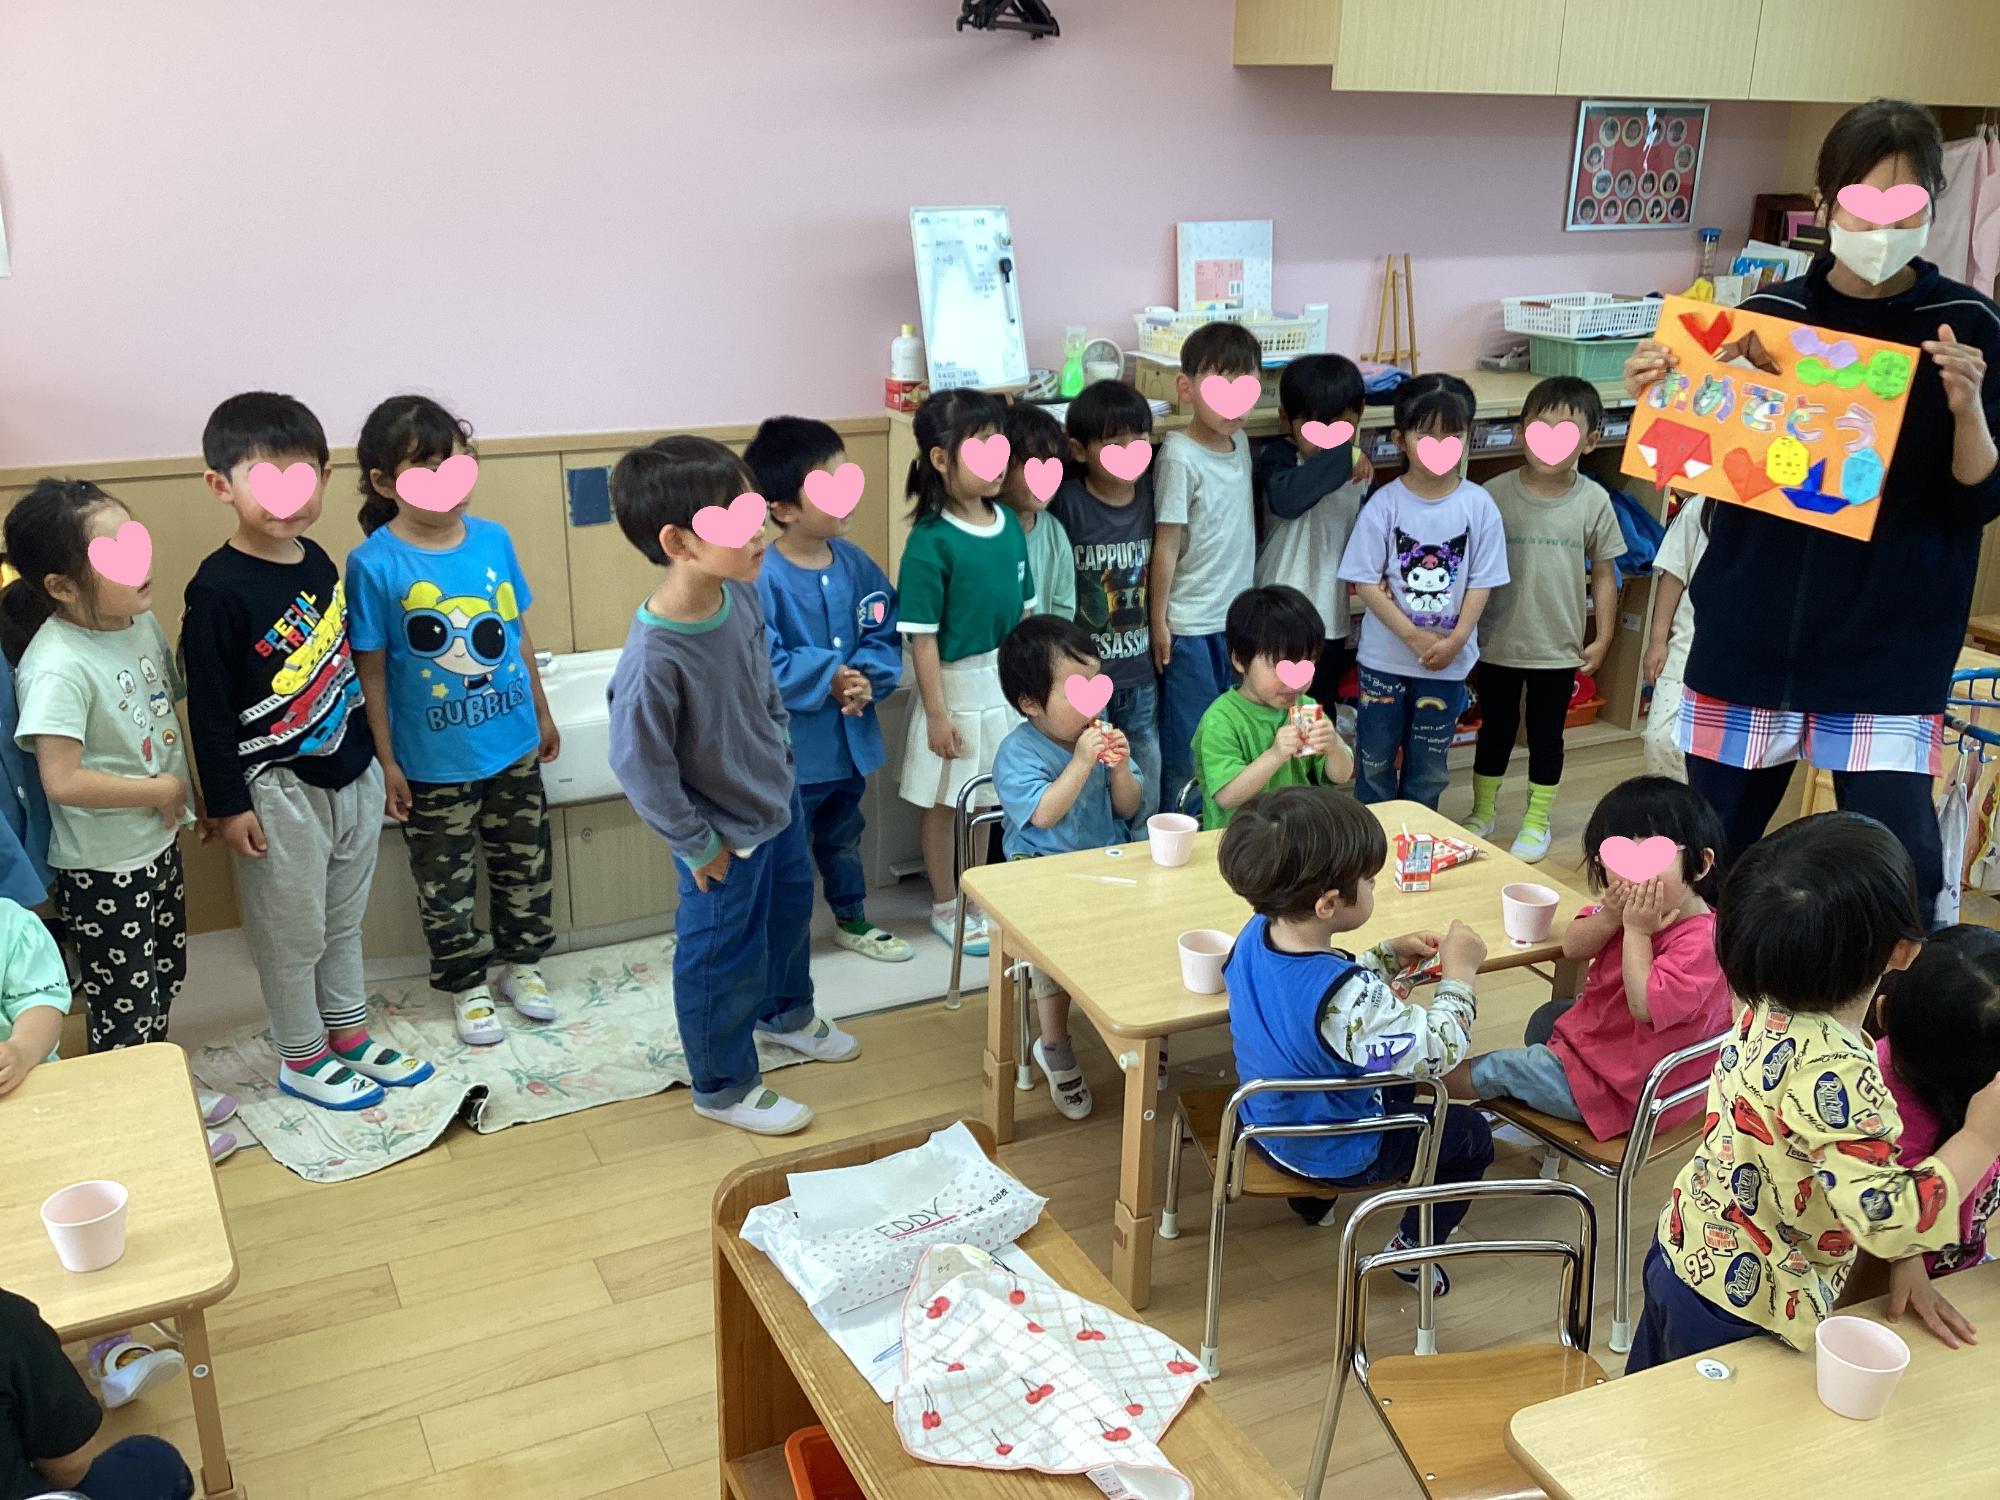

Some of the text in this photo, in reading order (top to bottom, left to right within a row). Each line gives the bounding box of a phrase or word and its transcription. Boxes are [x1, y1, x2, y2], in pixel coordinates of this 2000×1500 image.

[1646, 367, 1877, 453] おめでとう
[254, 590, 317, 657] SPECIAL
[277, 605, 321, 654] TRAIN
[416, 678, 525, 732] BUBBLES
[875, 1197, 943, 1237] EDDY
[988, 1187, 1009, 1206] 200枚
[1684, 1246, 1716, 1287] 95
[1725, 1256, 1759, 1303] Rusteze
